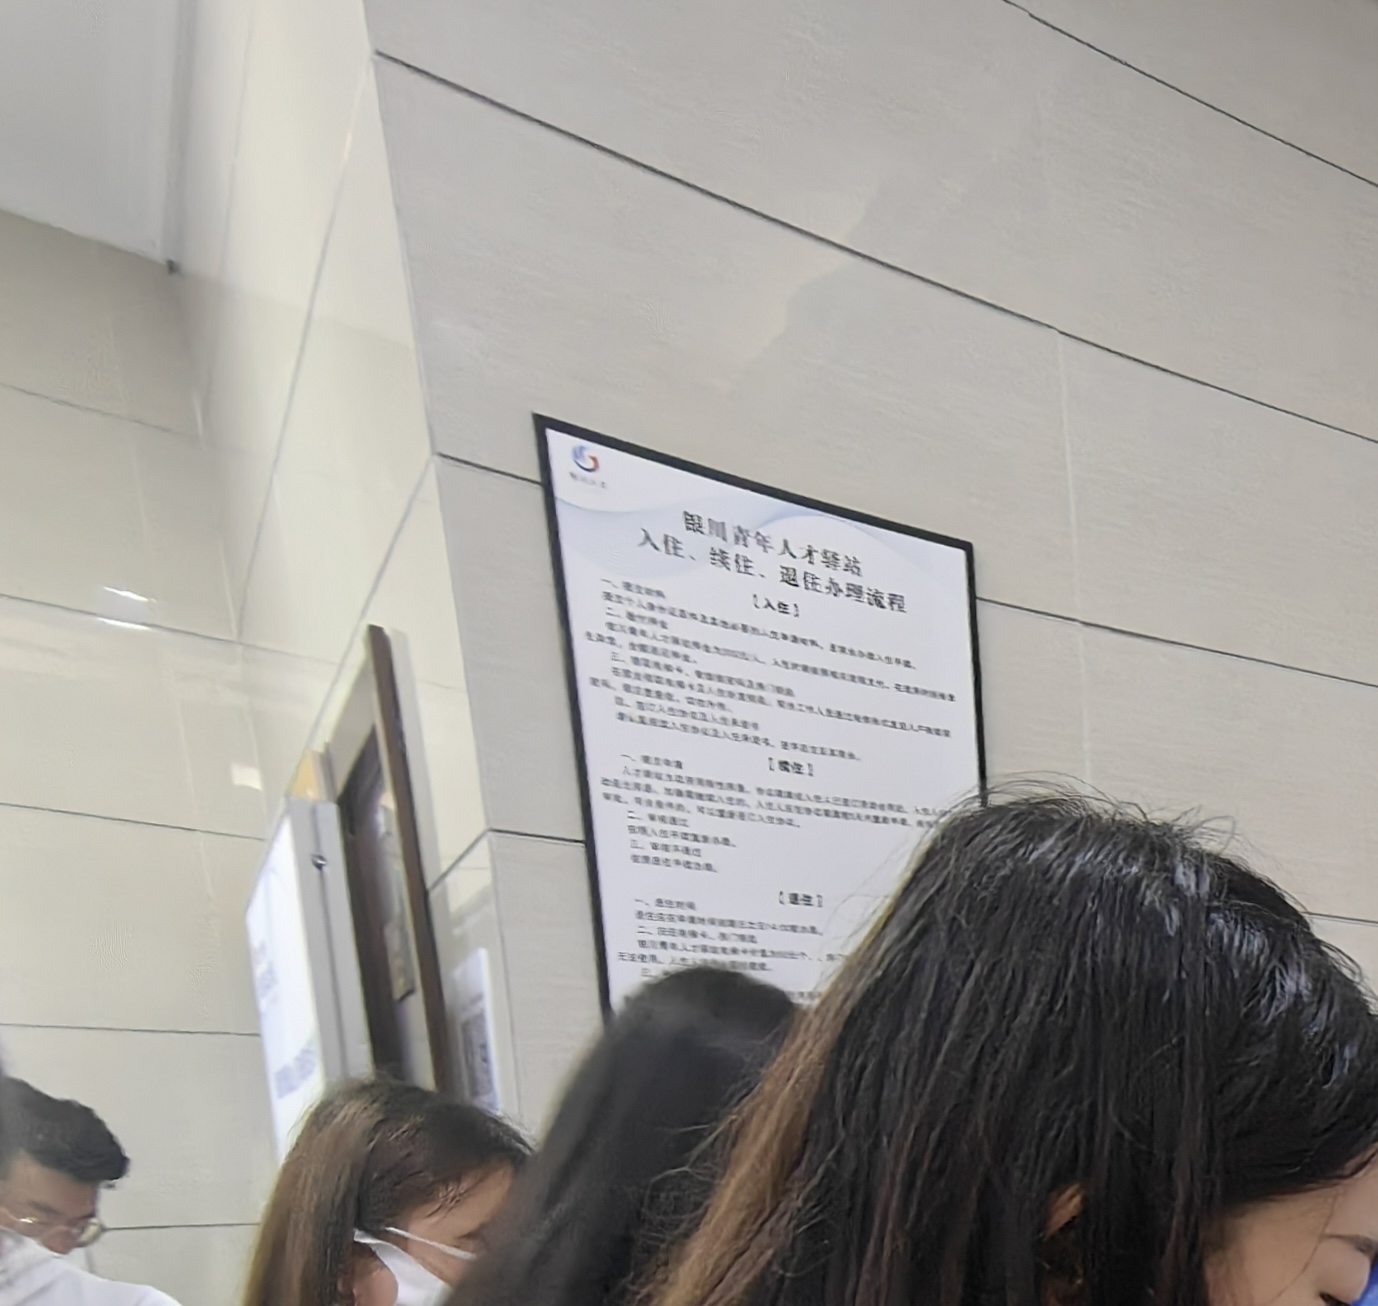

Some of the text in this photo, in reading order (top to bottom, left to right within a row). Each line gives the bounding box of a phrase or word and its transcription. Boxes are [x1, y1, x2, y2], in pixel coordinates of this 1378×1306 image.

[683, 510, 863, 577] 银川青年人才驿站
